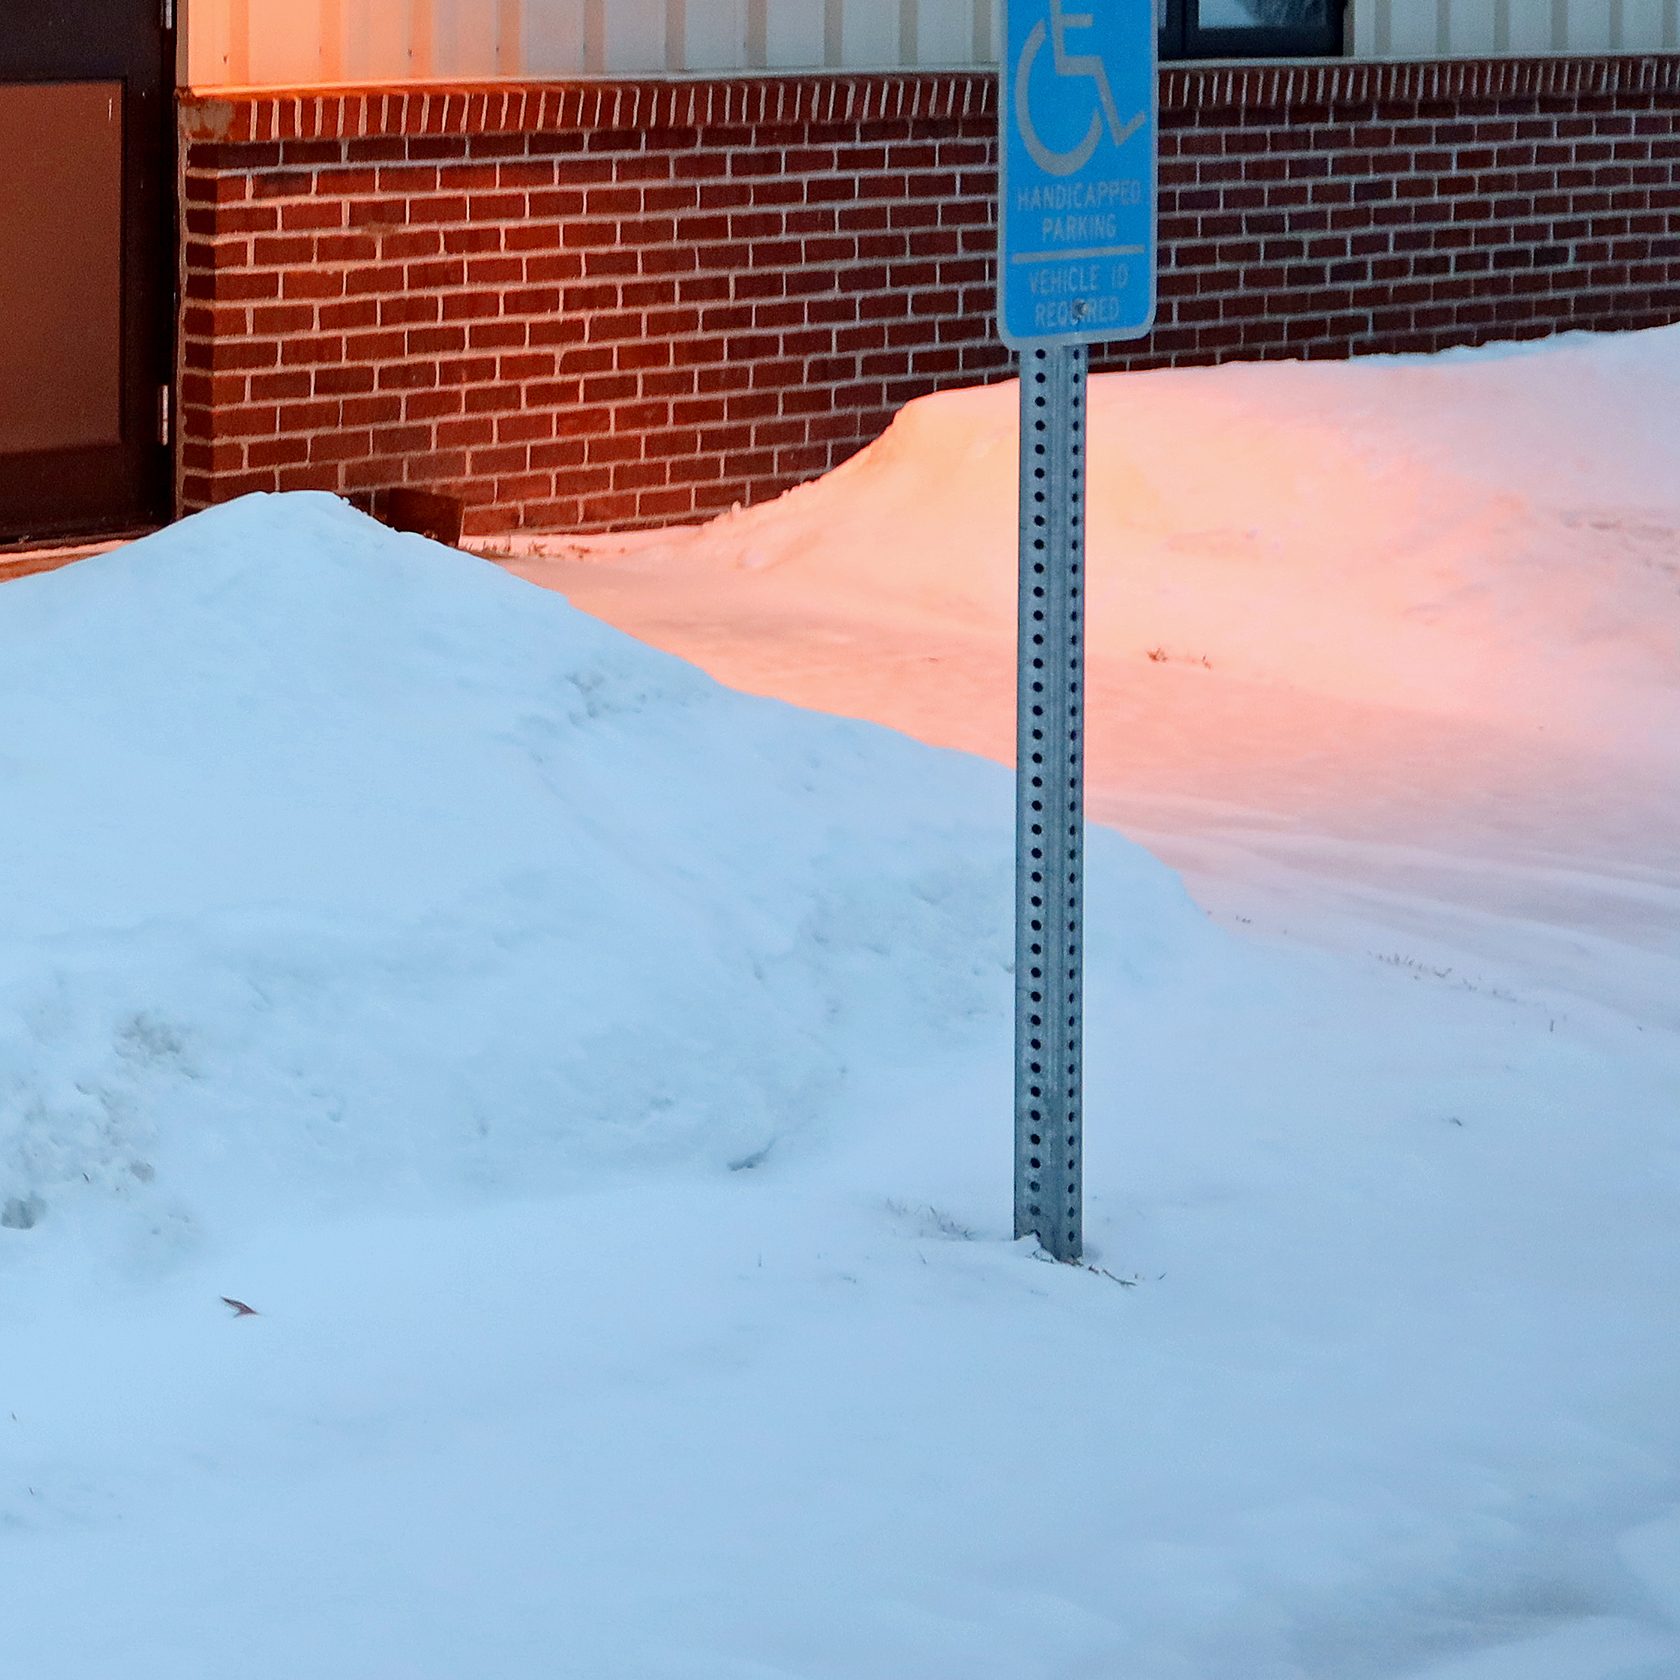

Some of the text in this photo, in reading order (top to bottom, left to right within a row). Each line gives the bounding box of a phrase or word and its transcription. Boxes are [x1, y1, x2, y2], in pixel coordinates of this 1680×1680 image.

[1017, 179, 1141, 212] HANDICAPPED
[1042, 213, 1117, 241] PARKING
[1028, 263, 1129, 295] VEHICLE ID
